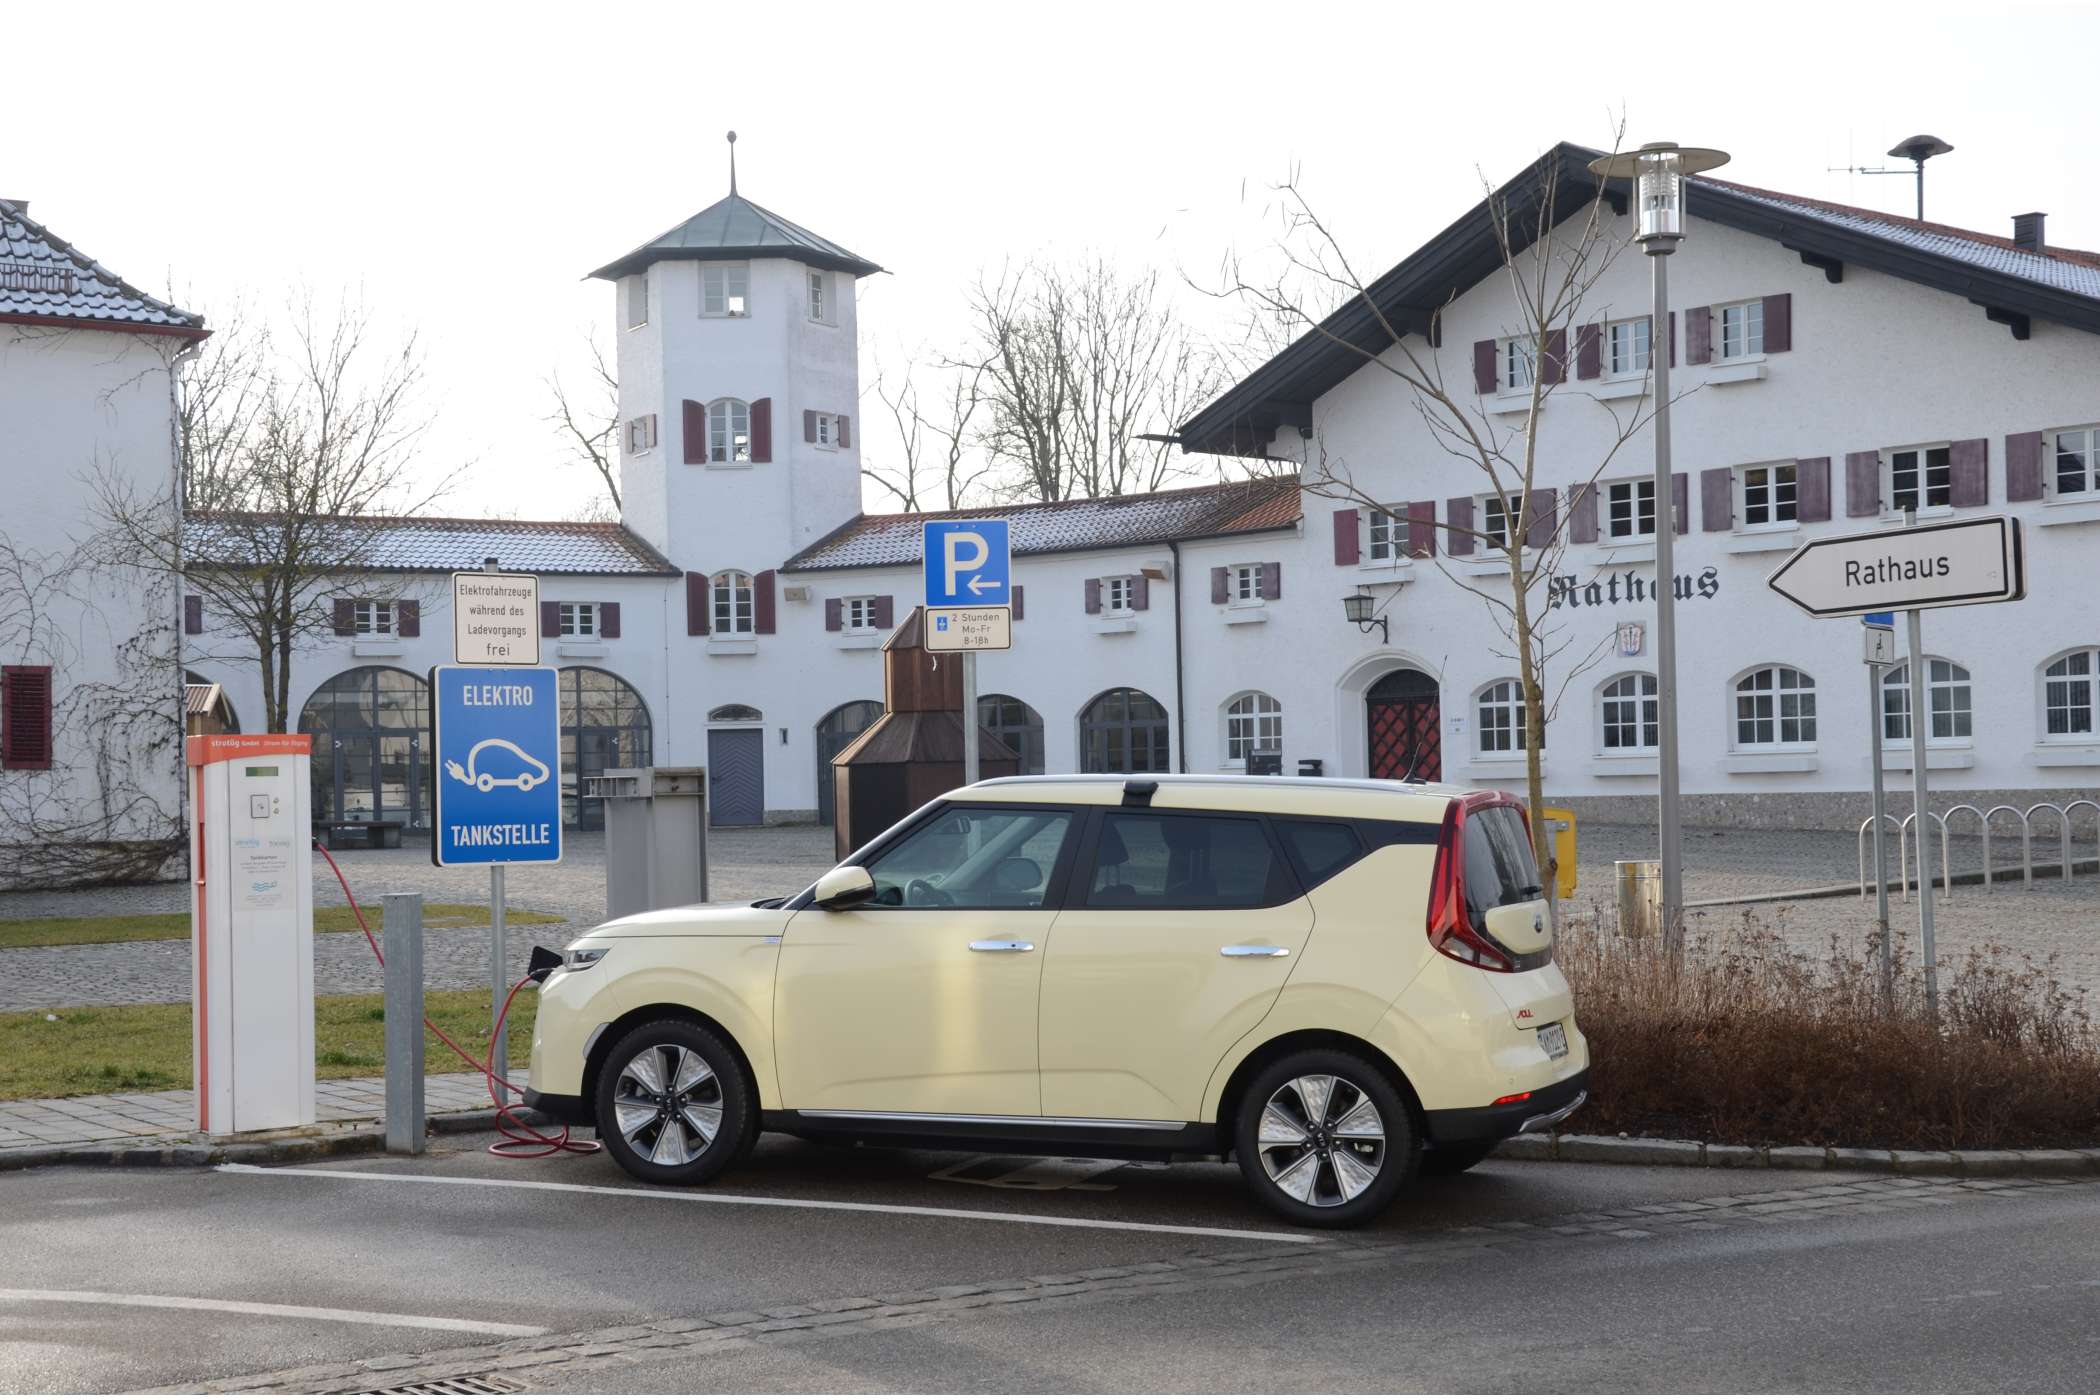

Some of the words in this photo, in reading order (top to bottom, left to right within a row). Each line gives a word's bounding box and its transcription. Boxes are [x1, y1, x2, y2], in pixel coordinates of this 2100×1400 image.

[944, 532, 989, 596] P
[1845, 556, 1950, 587] Rathaus
[460, 585, 532, 599] Elektrofahrzeuge
[1549, 566, 1720, 610] Rathus
[469, 604, 506, 616] während
[509, 604, 525, 616] des
[951, 613, 958, 622] 2
[961, 612, 1000, 622] Stunden
[467, 623, 527, 638] Ladevorgangs
[962, 625, 992, 635] Mo-Fr
[486, 642, 511, 657] frei
[463, 685, 533, 706] ELEKTRO
[451, 823, 550, 846] TANKSTELLE
